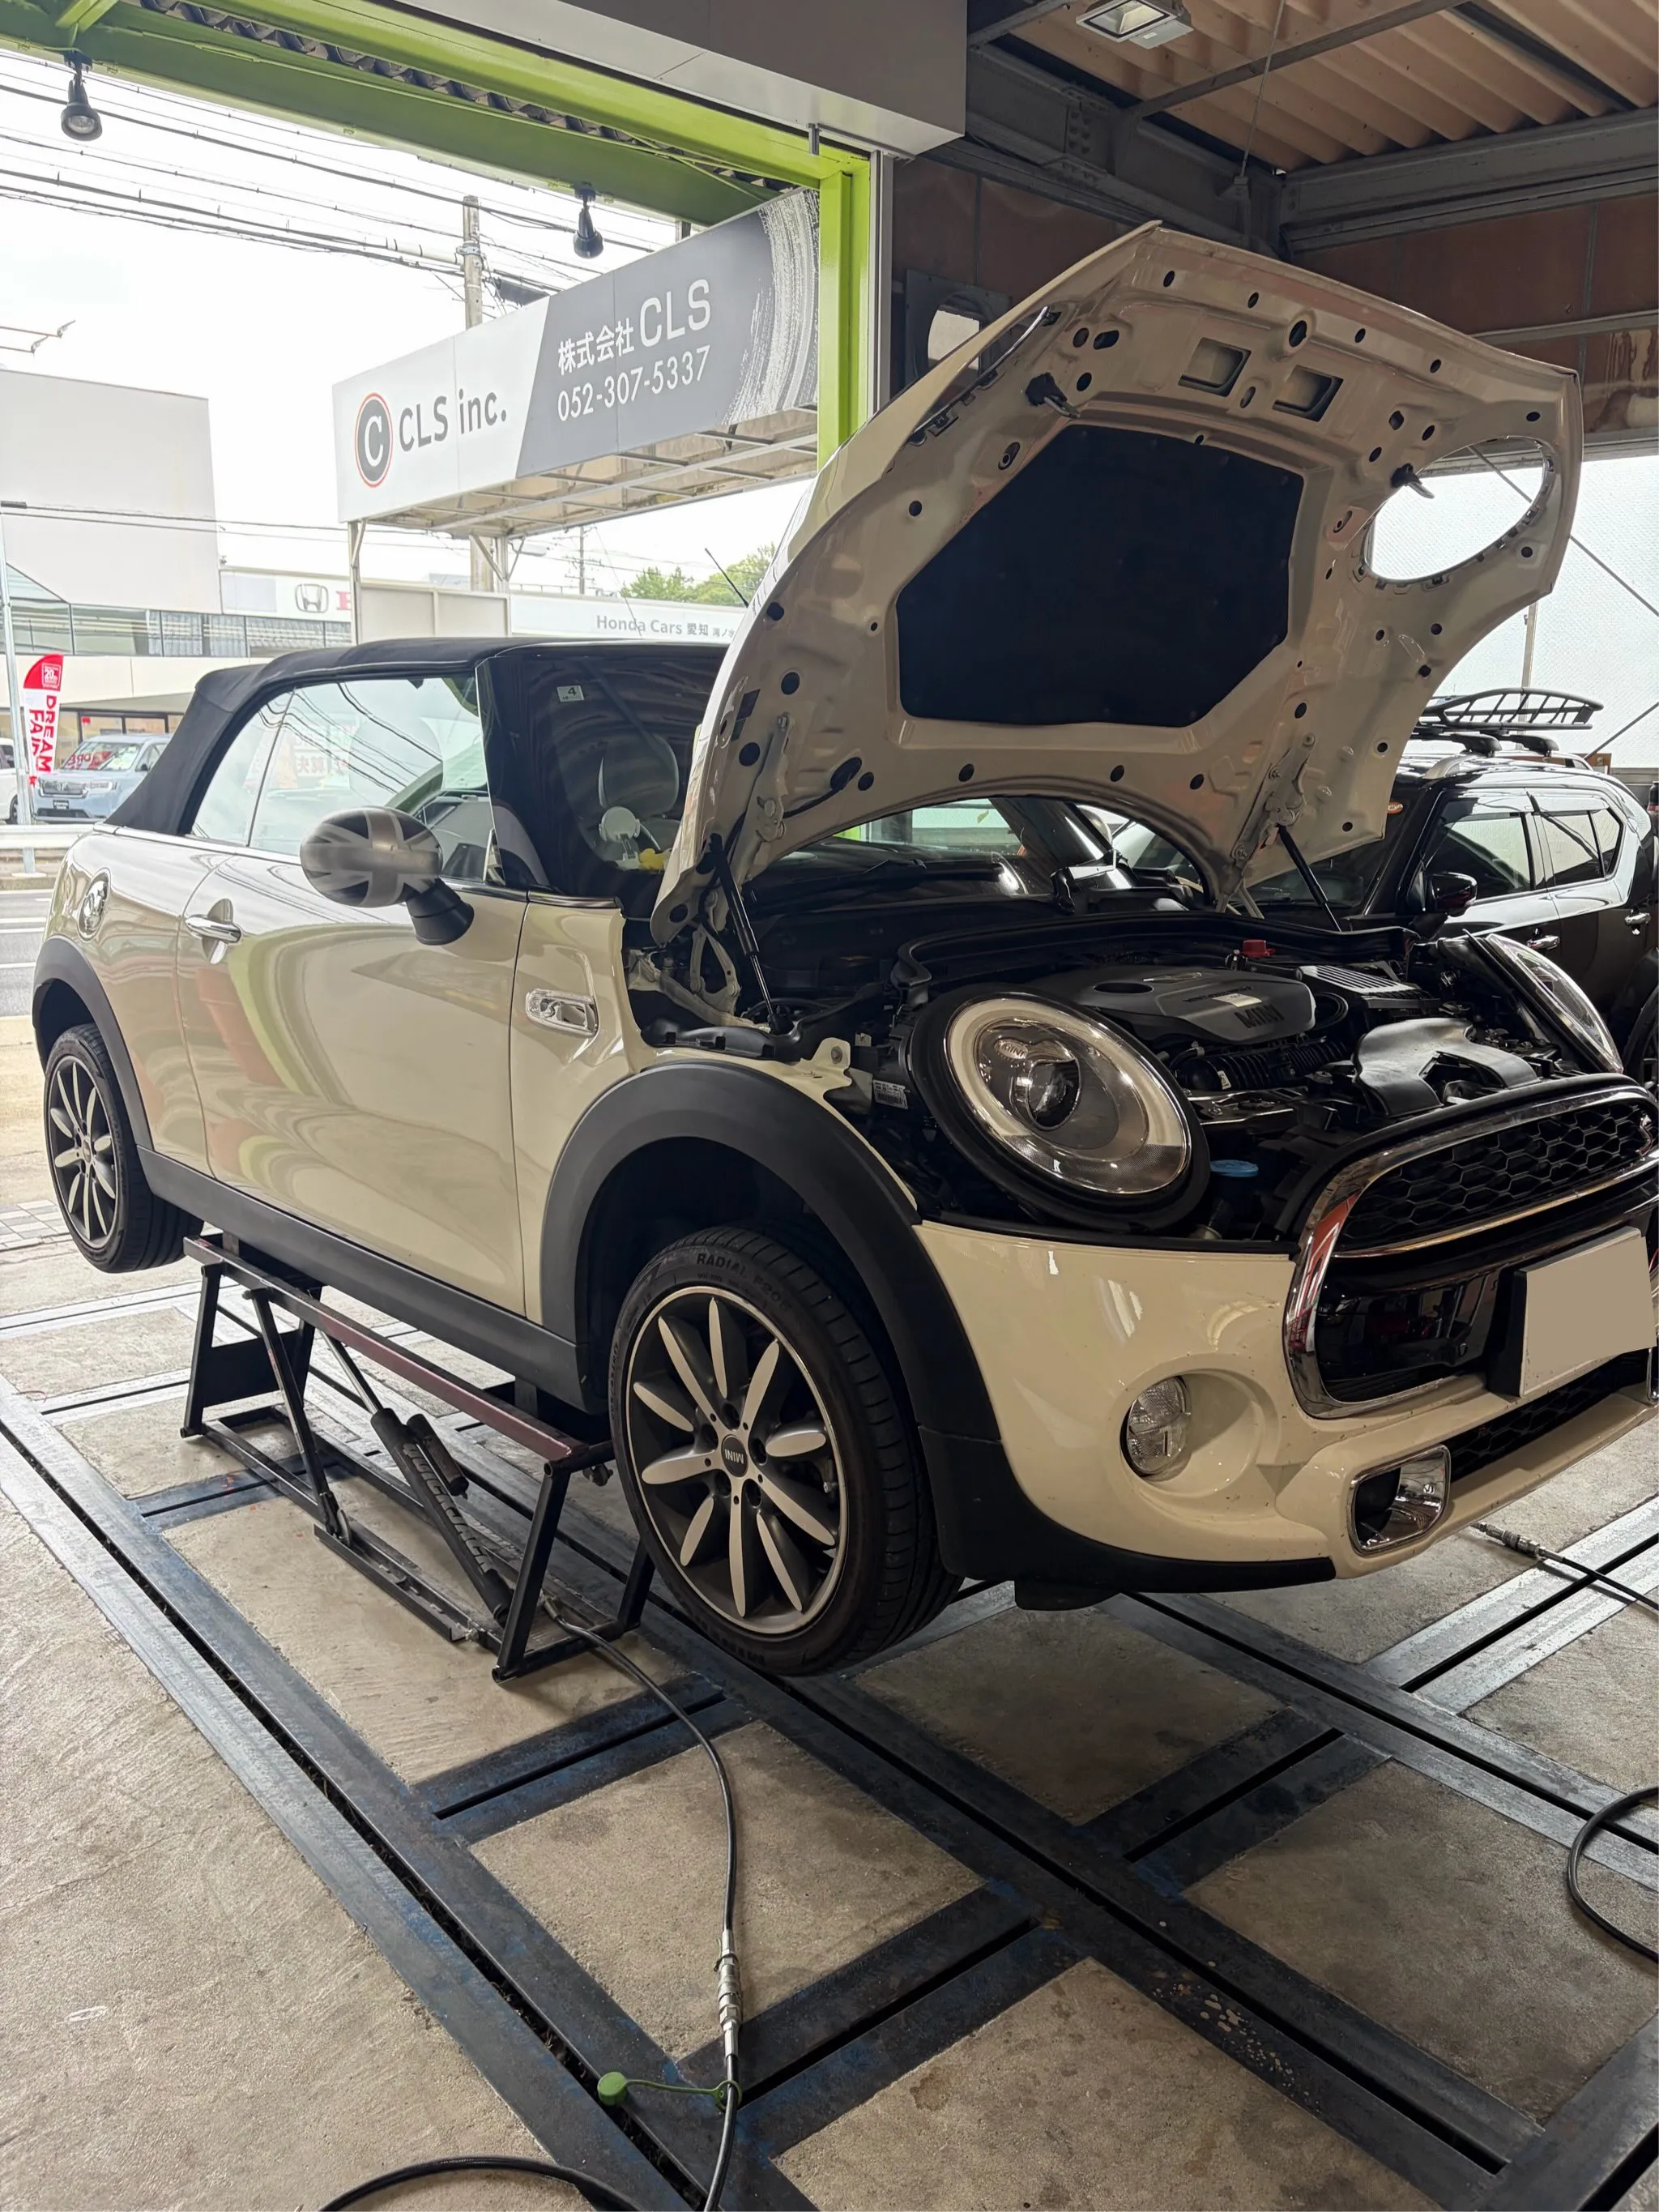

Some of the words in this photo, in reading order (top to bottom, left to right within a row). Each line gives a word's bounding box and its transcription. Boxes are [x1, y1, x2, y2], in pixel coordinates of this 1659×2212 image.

[557, 317, 635, 376] 株式会社
[639, 279, 711, 348] CLS
[557, 344, 710, 421] 052-307-5337
[399, 395, 449, 452] CLS
[458, 388, 507, 434] inc.
[596, 615, 646, 632] Honda
[650, 619, 683, 634] Cars
[687, 622, 709, 636] 愛知
[568, 687, 577, 695] 4
[36, 694, 58, 774] DREAM
[697, 1253, 748, 1277] RADIAL
[724, 1448, 744, 1465] MINI
